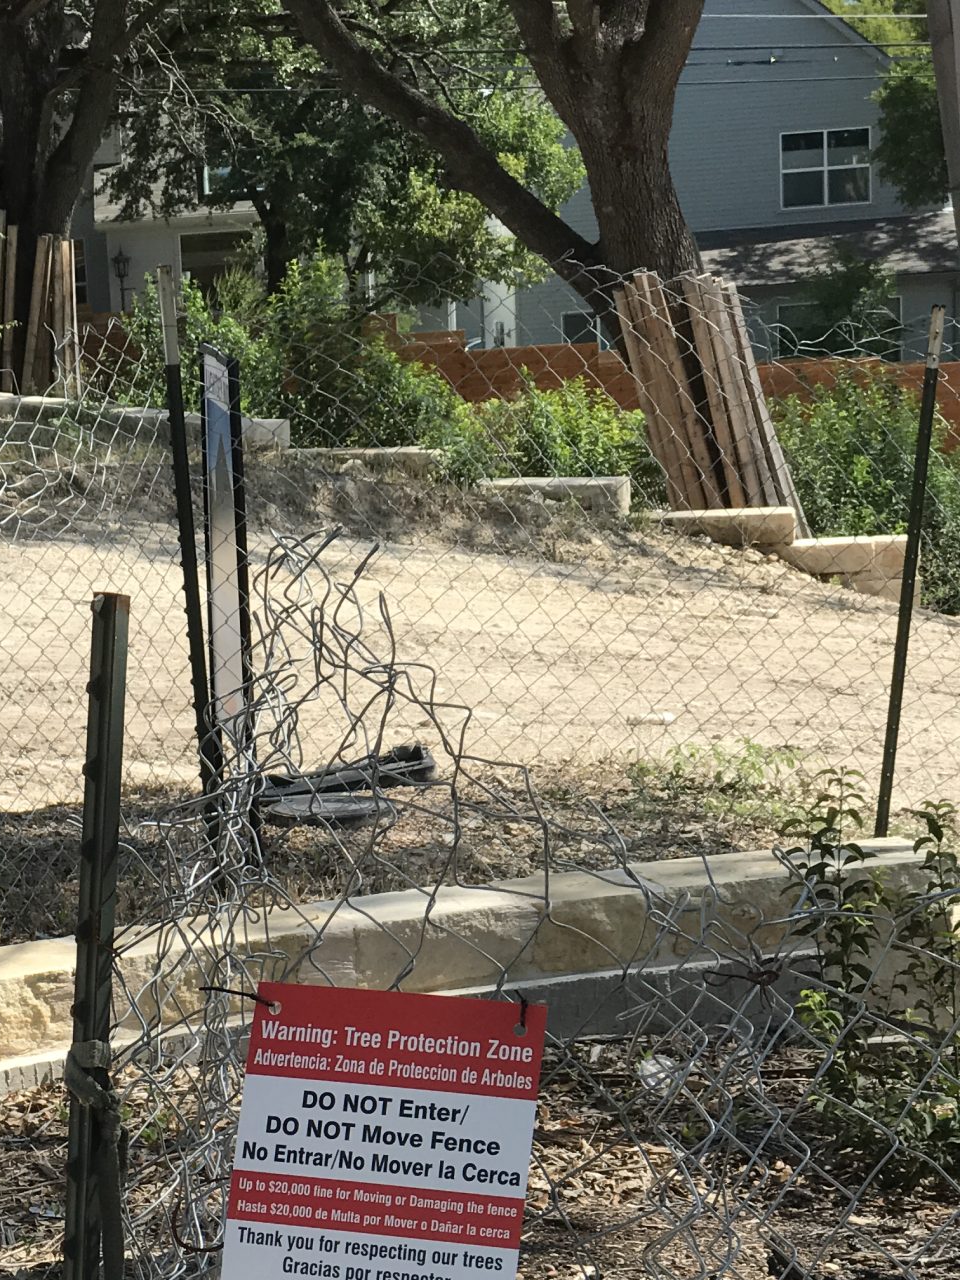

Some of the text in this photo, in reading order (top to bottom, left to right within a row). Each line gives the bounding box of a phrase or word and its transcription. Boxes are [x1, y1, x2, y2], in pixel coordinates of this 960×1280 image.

[261, 1020, 533, 1062] Warning: Tree Protection Zone
[254, 1048, 532, 1090] Advertencia: Zona de Proteccion de Arboles
[302, 1090, 470, 1125] DO NOT Enter/
[265, 1115, 501, 1156] DO NOT Move Fence
[242, 1141, 521, 1186] No Entrar/No Mover la Cerca
[239, 1177, 517, 1218] Up to $20,000 fine for Moving or Damaging the fence
[237, 1200, 510, 1239] Hasta $20,000 de Multa por Mover o Dañar la cerca
[238, 1226, 503, 1271] Thank you for respecting our trees
[282, 1257, 340, 1279] Gracias
